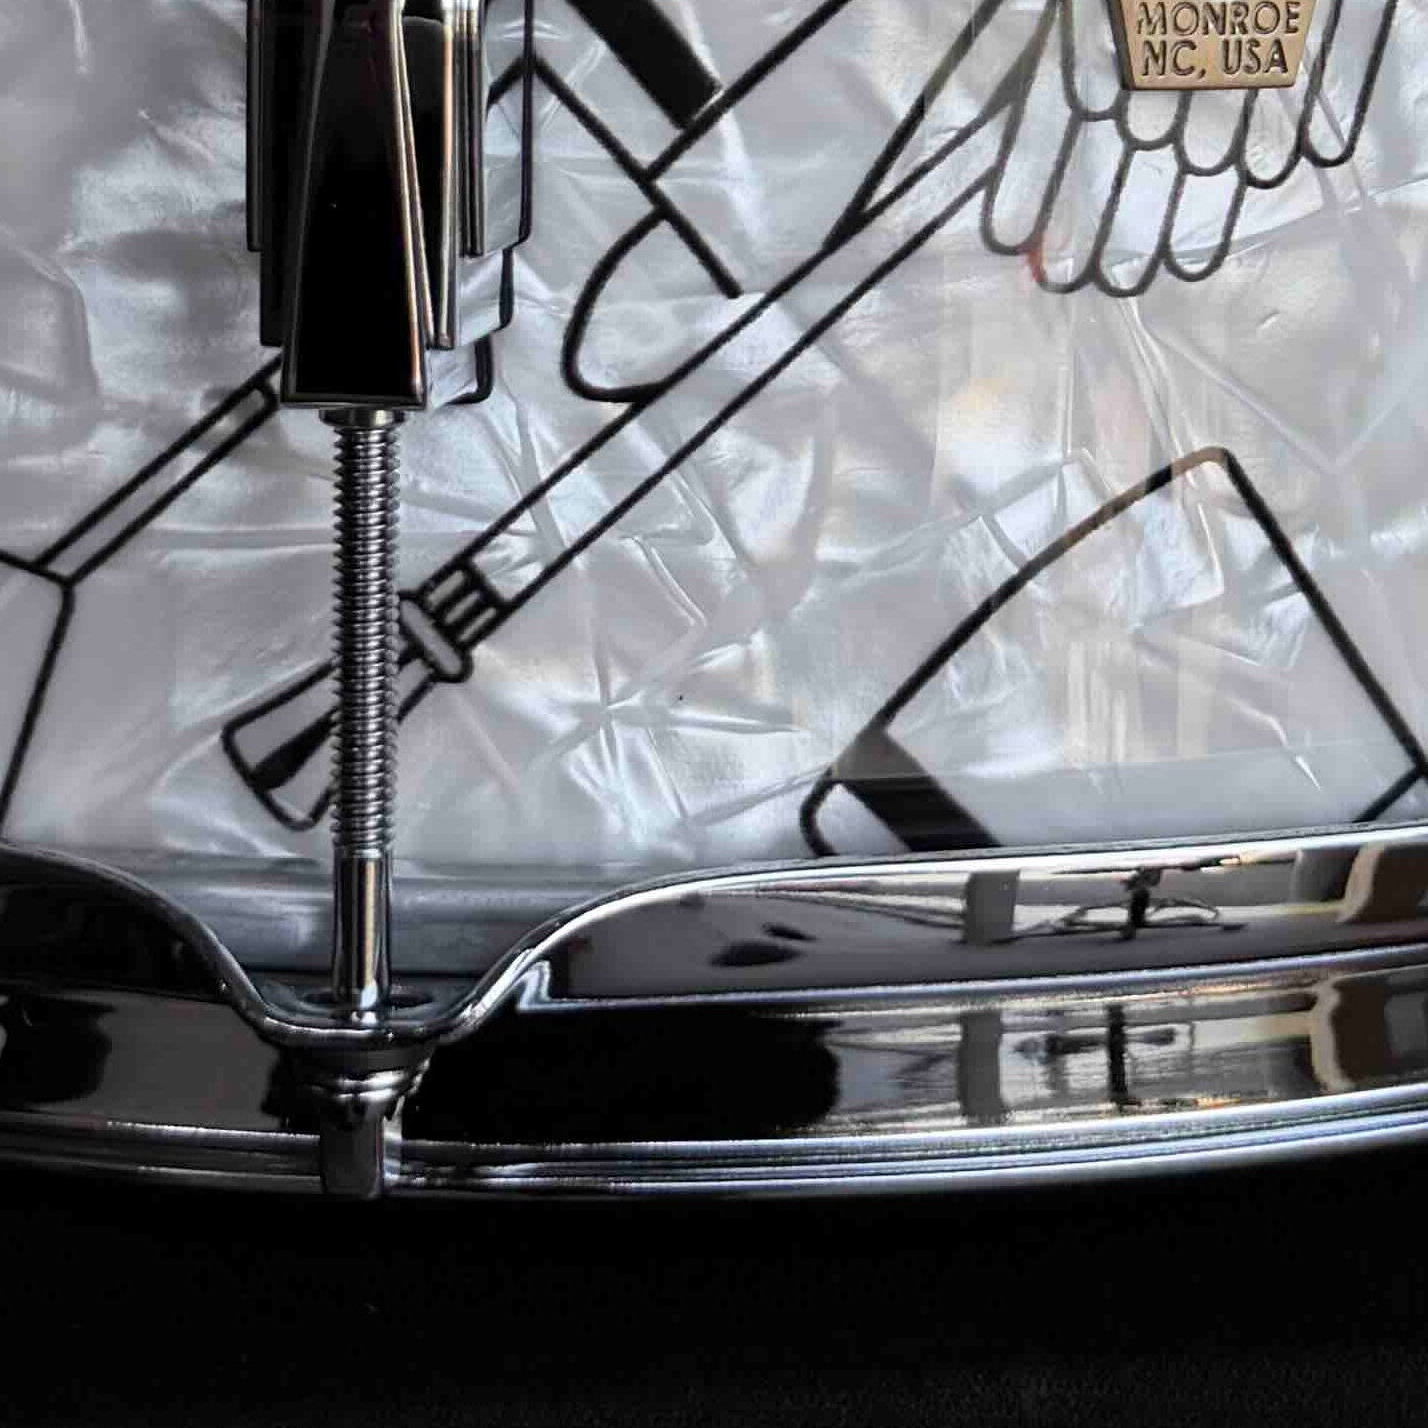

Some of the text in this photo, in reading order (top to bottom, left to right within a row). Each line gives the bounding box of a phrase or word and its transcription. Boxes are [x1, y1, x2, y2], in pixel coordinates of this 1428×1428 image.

[1136, 1, 1302, 36] MONROE
[1140, 40, 1290, 79] NC, USA
